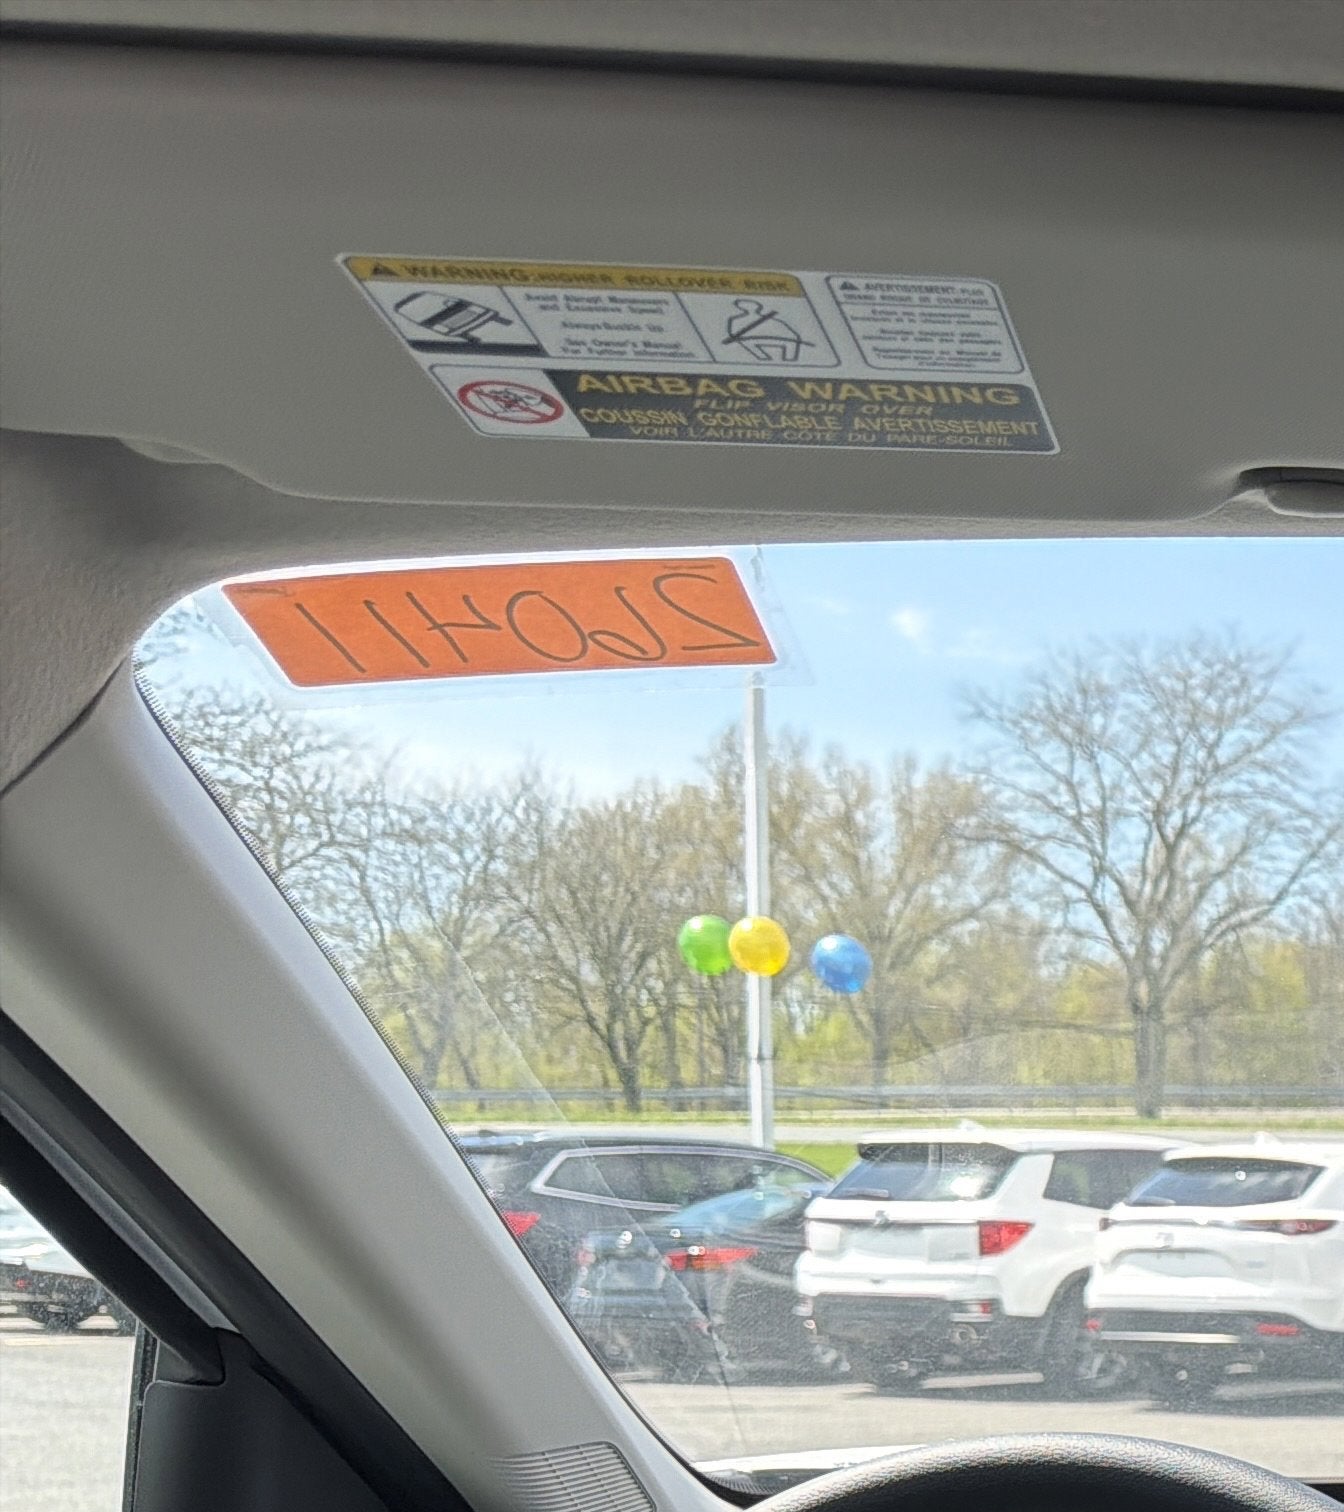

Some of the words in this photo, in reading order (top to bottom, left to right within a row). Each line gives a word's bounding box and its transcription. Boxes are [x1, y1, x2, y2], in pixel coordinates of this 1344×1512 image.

[576, 373, 765, 399] AIRBAG
[786, 380, 1021, 406] WARNING
[694, 398, 752, 411] FLIP
[767, 401, 845, 415] VISOR
[860, 403, 934, 416] OVER
[578, 407, 689, 426] COUSSIN
[697, 411, 843, 431] GONFLABLE
[853, 416, 1040, 436] AVERTISSEMENT
[629, 426, 678, 438] VOIR
[686, 426, 772, 440] L'AUTRE
[848, 432, 876, 443] DU
